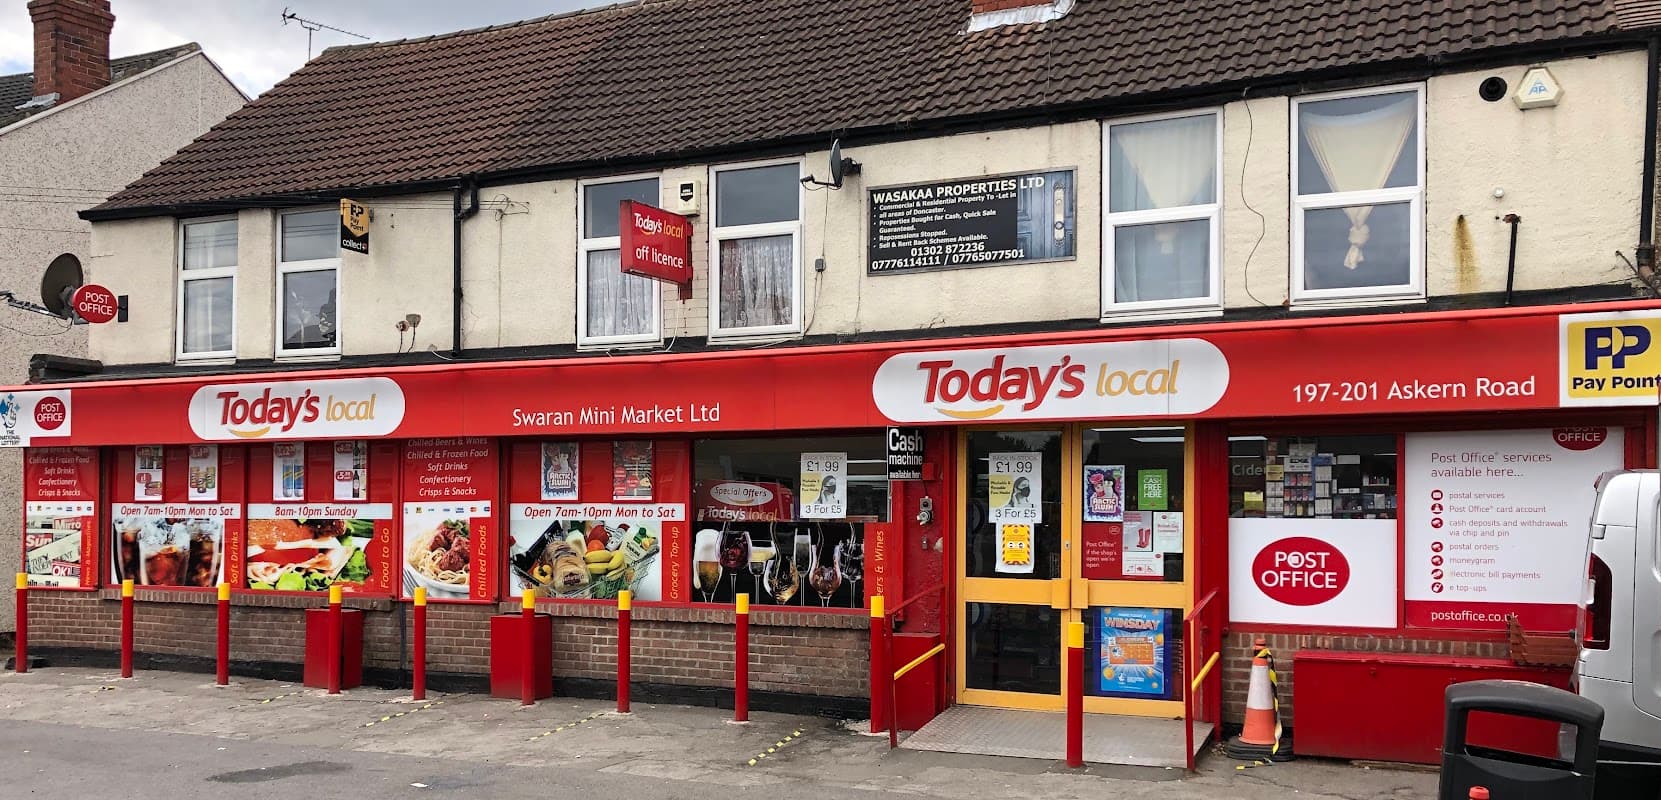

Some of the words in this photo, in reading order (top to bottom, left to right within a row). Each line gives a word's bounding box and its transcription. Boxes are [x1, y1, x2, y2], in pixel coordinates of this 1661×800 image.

[873, 188, 933, 204] WASAKAA
[937, 179, 1016, 198] PROPERTIES
[1020, 177, 1045, 189] LTD
[879, 202, 914, 211] Commercial
[922, 197, 956, 206] Residential
[958, 194, 985, 204] Property
[914, 207, 946, 215] Doncaster.
[879, 218, 910, 226] Properties
[911, 216, 933, 224] Bought
[963, 210, 981, 218] Quick
[634, 212, 662, 235] Today's
[663, 220, 684, 239] local
[929, 236, 956, 244] Schemes
[911, 246, 943, 256] 01302
[946, 242, 984, 254] 872236
[635, 245, 649, 261] off
[651, 248, 683, 268] licence
[872, 256, 940, 270] 07776114111
[952, 250, 1024, 263] 07765077501
[85, 292, 109, 304] POST
[79, 301, 113, 316] OFFICE
[917, 354, 1086, 411] Today's
[1096, 359, 1180, 397] local
[1572, 376, 1605, 391] Pay
[1611, 373, 1661, 389] Point
[1293, 381, 1379, 403] 197-201
[1387, 379, 1466, 399] Askern
[1476, 376, 1535, 397] Road
[41, 403, 60, 412] POST
[217, 388, 320, 432] Today's
[325, 393, 376, 422] local
[37, 413, 63, 422] OFFICE
[513, 408, 575, 427] Swaran
[579, 406, 615, 426] Mini
[621, 405, 683, 425] Market
[689, 403, 721, 423] Ltd
[889, 429, 923, 451] Cash
[1557, 432, 1601, 442] OFFICE
[408, 451, 433, 460] Chilled
[435, 451, 441, 459] &
[442, 450, 468, 458] Frozen
[470, 449, 489, 457] Food
[889, 452, 923, 465] machine
[1431, 453, 1457, 464] Post
[1503, 453, 1552, 463] services
[427, 463, 443, 472] Soft
[445, 462, 468, 470] Drinks
[806, 461, 839, 472] £1.99
[996, 462, 1033, 473] £1.99
[1431, 466, 1482, 478] available
[1486, 466, 1524, 477] here...
[38, 478, 77, 486] Confectionery
[420, 475, 472, 484] Confectionery
[38, 489, 55, 497] Crisps
[62, 488, 80, 496] Snacks
[419, 488, 442, 498] Crisps
[452, 487, 477, 495] Snacks
[714, 486, 741, 497] Special
[1449, 492, 1472, 500] postal
[121, 506, 140, 516] Open
[144, 506, 185, 516] 7am-10pm
[188, 507, 205, 516] Mon
[208, 507, 217, 516] to
[220, 506, 233, 516] Sat
[275, 506, 321, 517] 8am-10pm
[325, 507, 357, 518] Sunday
[524, 507, 551, 519] Open
[555, 507, 612, 519] 7am-10pm
[615, 507, 638, 518] Mon
[642, 507, 653, 518] to
[657, 507, 676, 518] Sat
[707, 505, 746, 520] Today's
[805, 506, 810, 514] 3
[813, 505, 829, 514] For
[831, 505, 841, 514] £5
[995, 510, 1001, 518] 3
[1005, 509, 1021, 518] For
[1024, 509, 1036, 518] £5
[1449, 519, 1466, 527] cash
[1468, 519, 1500, 529] deposits
[381, 528, 389, 544] Go
[1449, 529, 1460, 537] via
[1462, 529, 1478, 539] chip
[1480, 529, 1495, 537] and
[1497, 529, 1510, 539] pin
[478, 525, 487, 557] Foods
[670, 527, 680, 558] Top-up
[875, 530, 884, 561] Wines
[382, 548, 389, 558] to
[1449, 543, 1472, 552] postal
[1275, 552, 1330, 569] POST
[1449, 557, 1495, 566] moneygram
[231, 562, 239, 584] Soft
[381, 561, 389, 588] Food
[478, 560, 487, 598] Chilled
[1502, 572, 1541, 581] payments
[670, 562, 680, 599] Grocery
[1261, 570, 1337, 589] OFFICE
[1456, 584, 1487, 592] top-ups
[1104, 617, 1160, 630] WINSDAY
